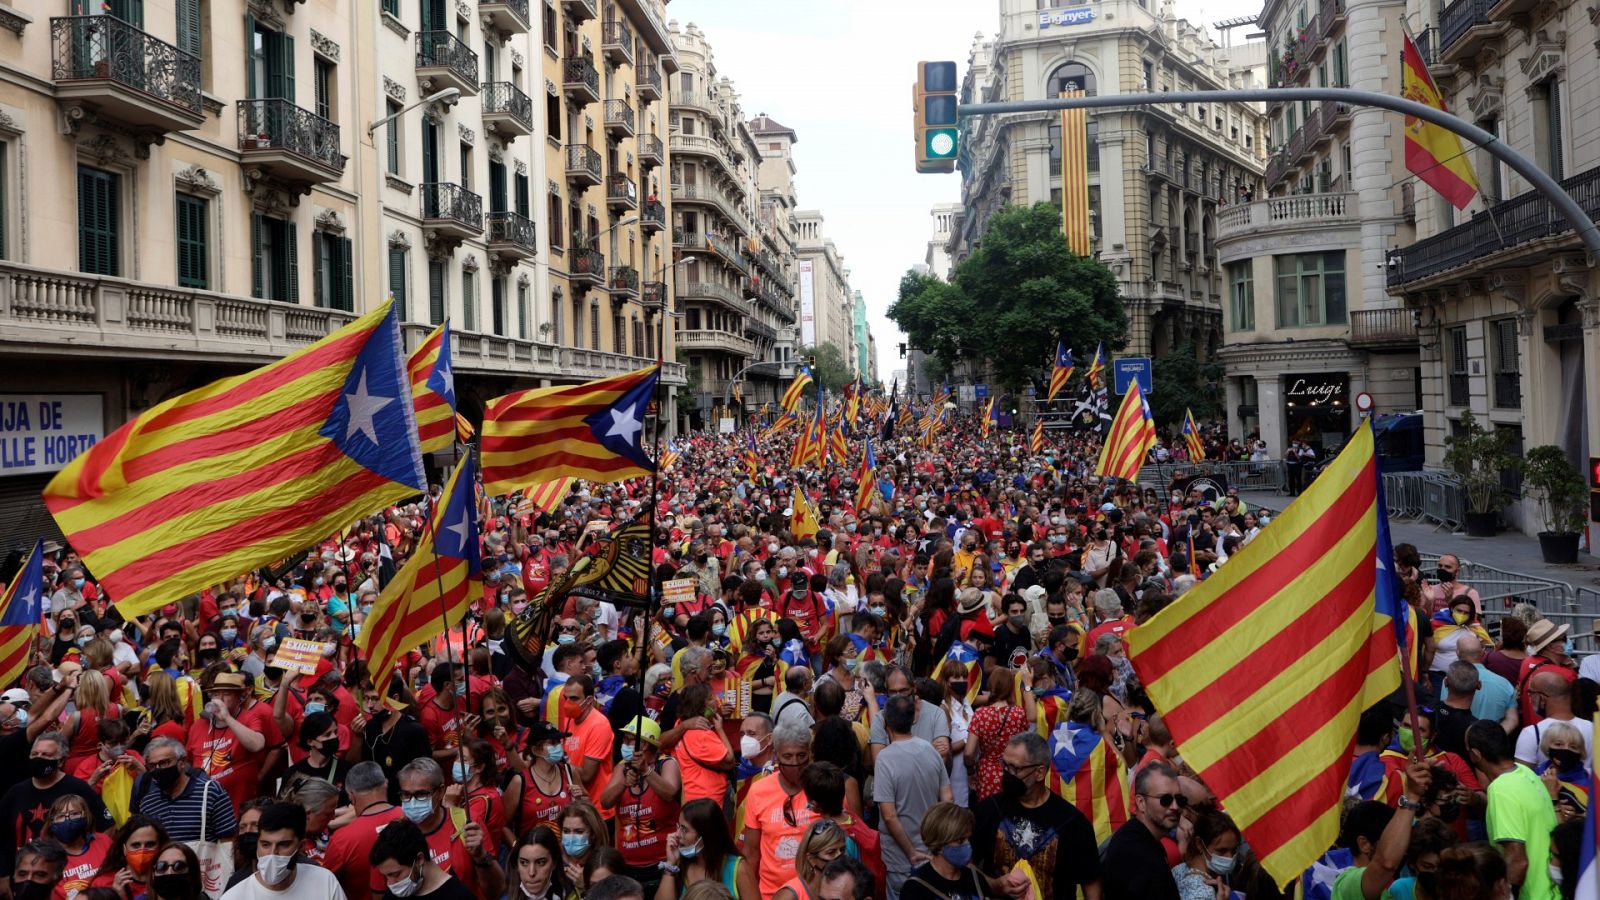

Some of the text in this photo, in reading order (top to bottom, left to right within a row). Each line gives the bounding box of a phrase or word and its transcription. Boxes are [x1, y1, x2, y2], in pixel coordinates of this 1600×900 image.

[1040, 10, 1098, 25] Enginyers
[1288, 379, 1343, 403] Luigi
[39, 401, 63, 430] DE
[286, 640, 319, 652] EXIGIM
[294, 652, 302, 660] LA
